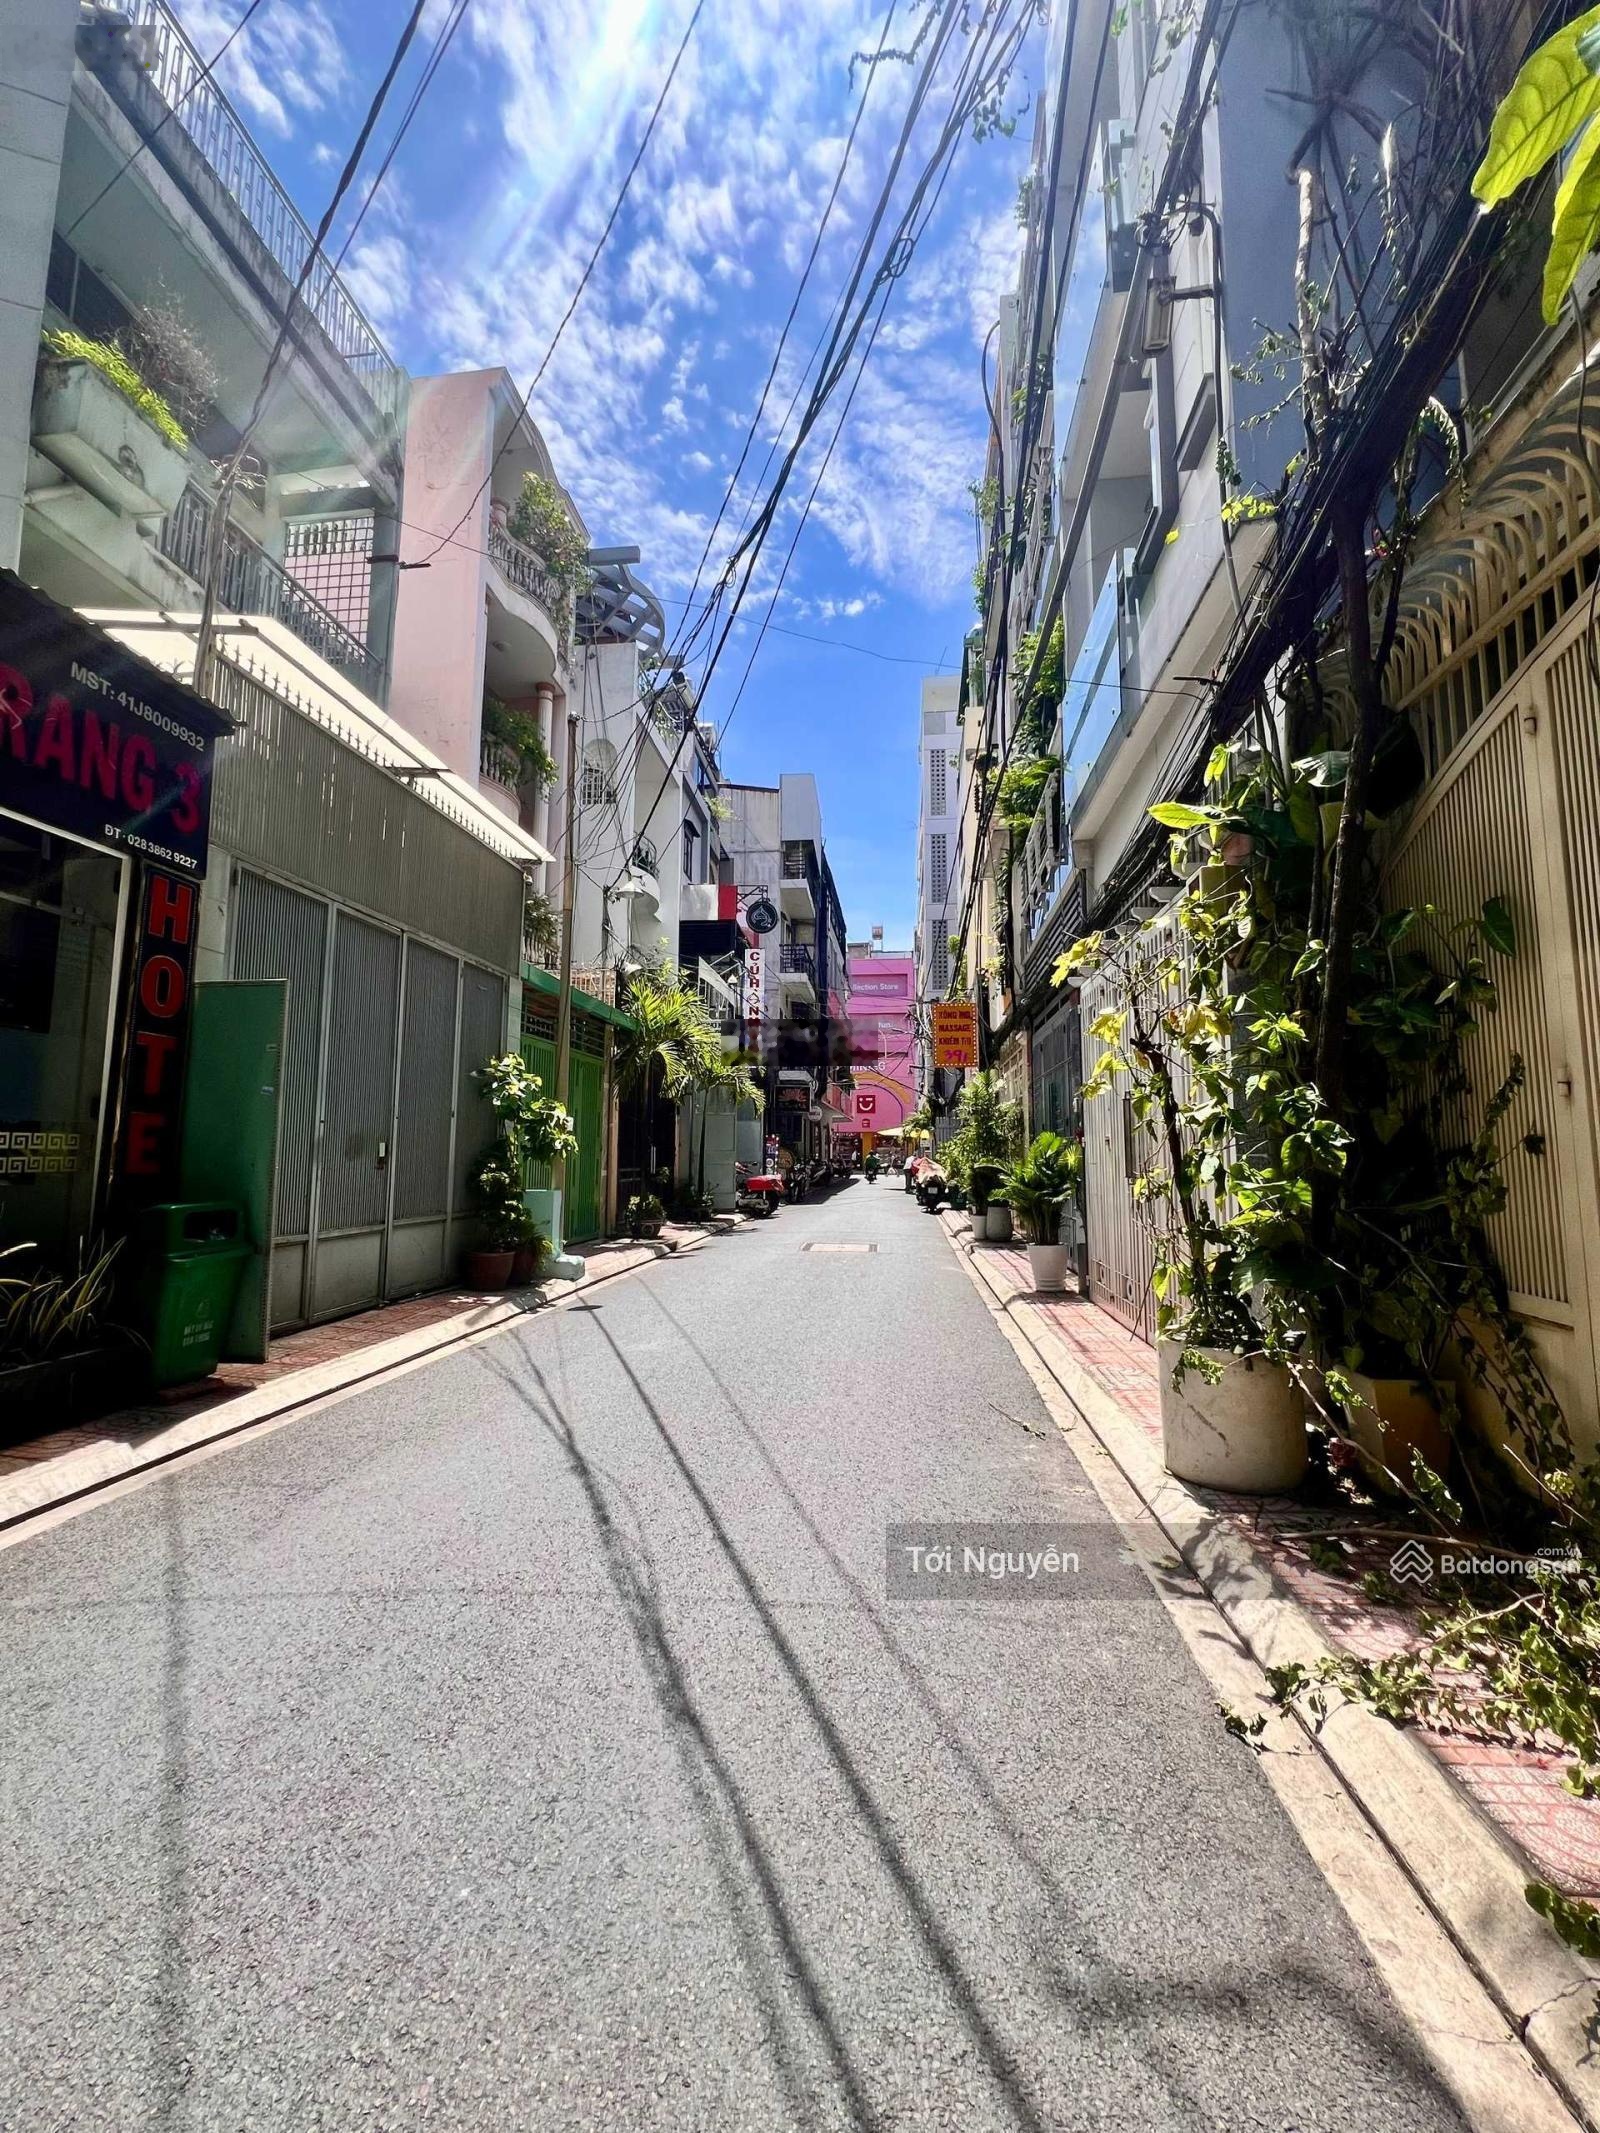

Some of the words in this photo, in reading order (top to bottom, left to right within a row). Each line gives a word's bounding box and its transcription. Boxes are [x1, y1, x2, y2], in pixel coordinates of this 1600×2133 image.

[71, 661, 115, 700] MST:
[117, 691, 205, 751] 41J8009932
[171, 761, 201, 834] 3
[127, 833, 147, 850] 028
[147, 842, 172, 860] 3862
[173, 852, 198, 869] 9227
[880, 983, 899, 991] Store
[938, 1024, 972, 1032] MASSAGE
